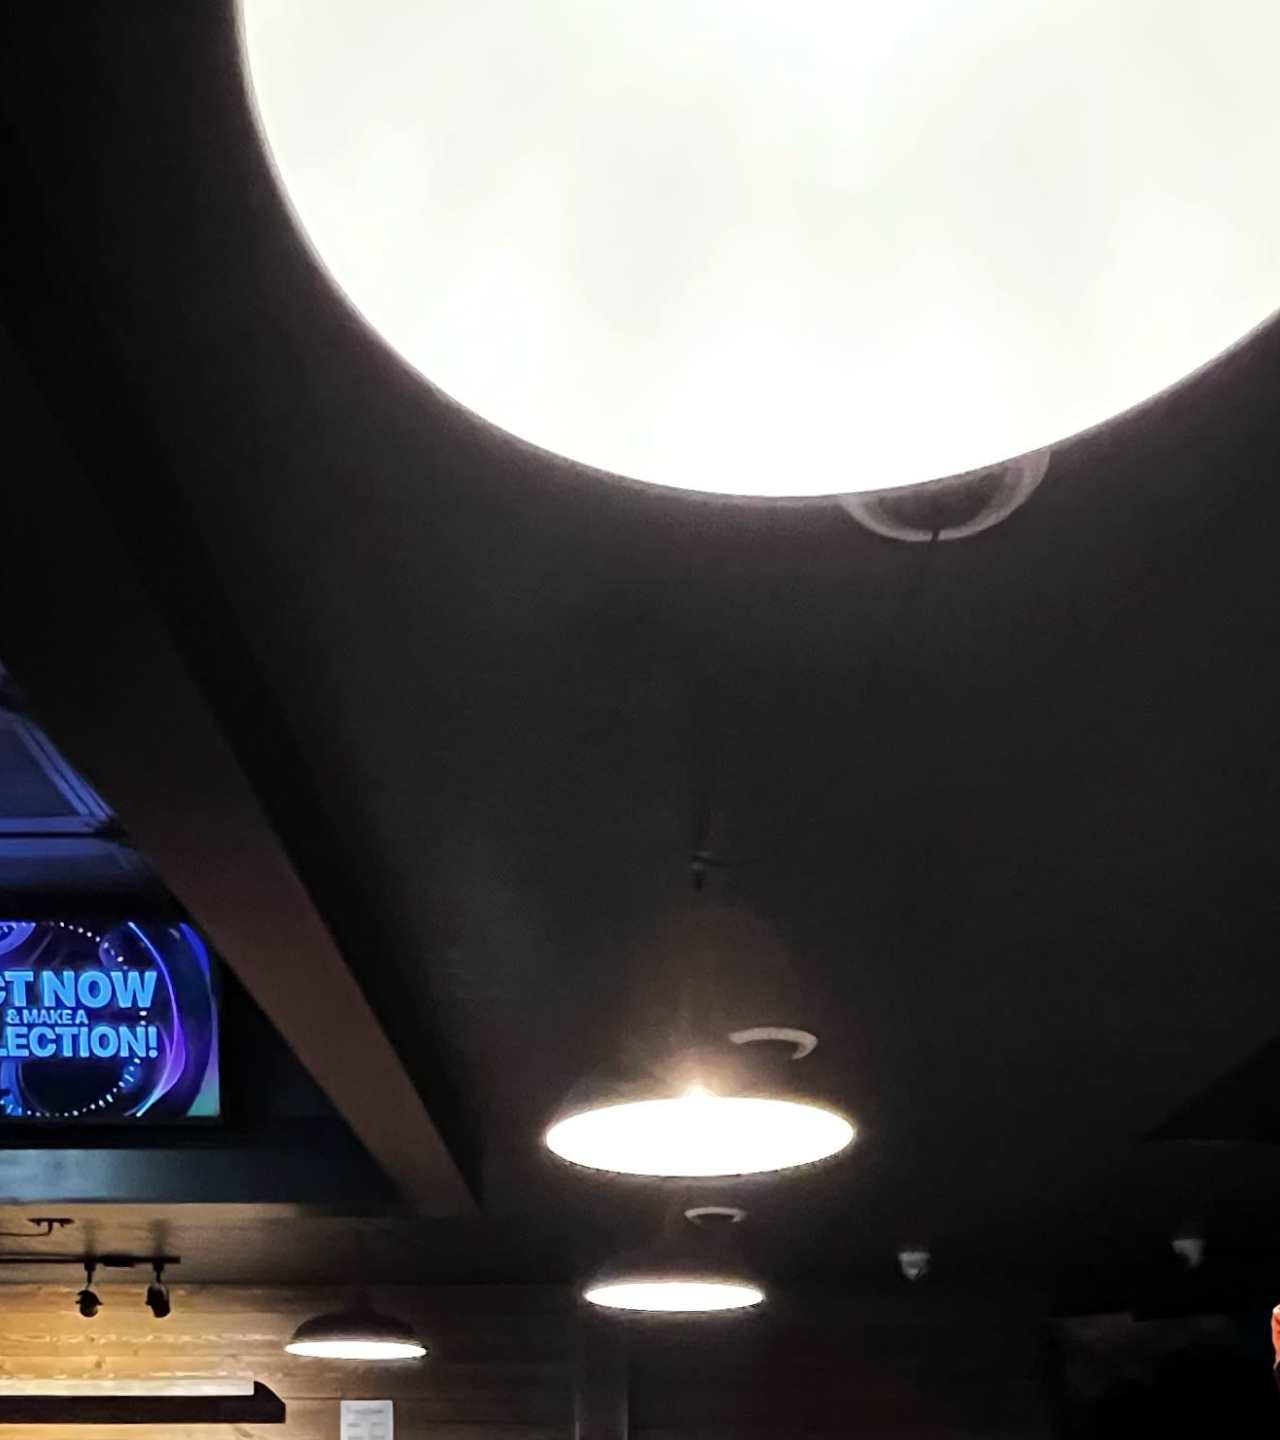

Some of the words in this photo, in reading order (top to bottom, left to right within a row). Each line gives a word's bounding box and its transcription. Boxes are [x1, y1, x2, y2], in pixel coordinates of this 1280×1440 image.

[41, 970, 158, 1008] NOW
[7, 1009, 19, 1024] &
[23, 1009, 72, 1024] MAKE
[75, 1009, 89, 1024] A
